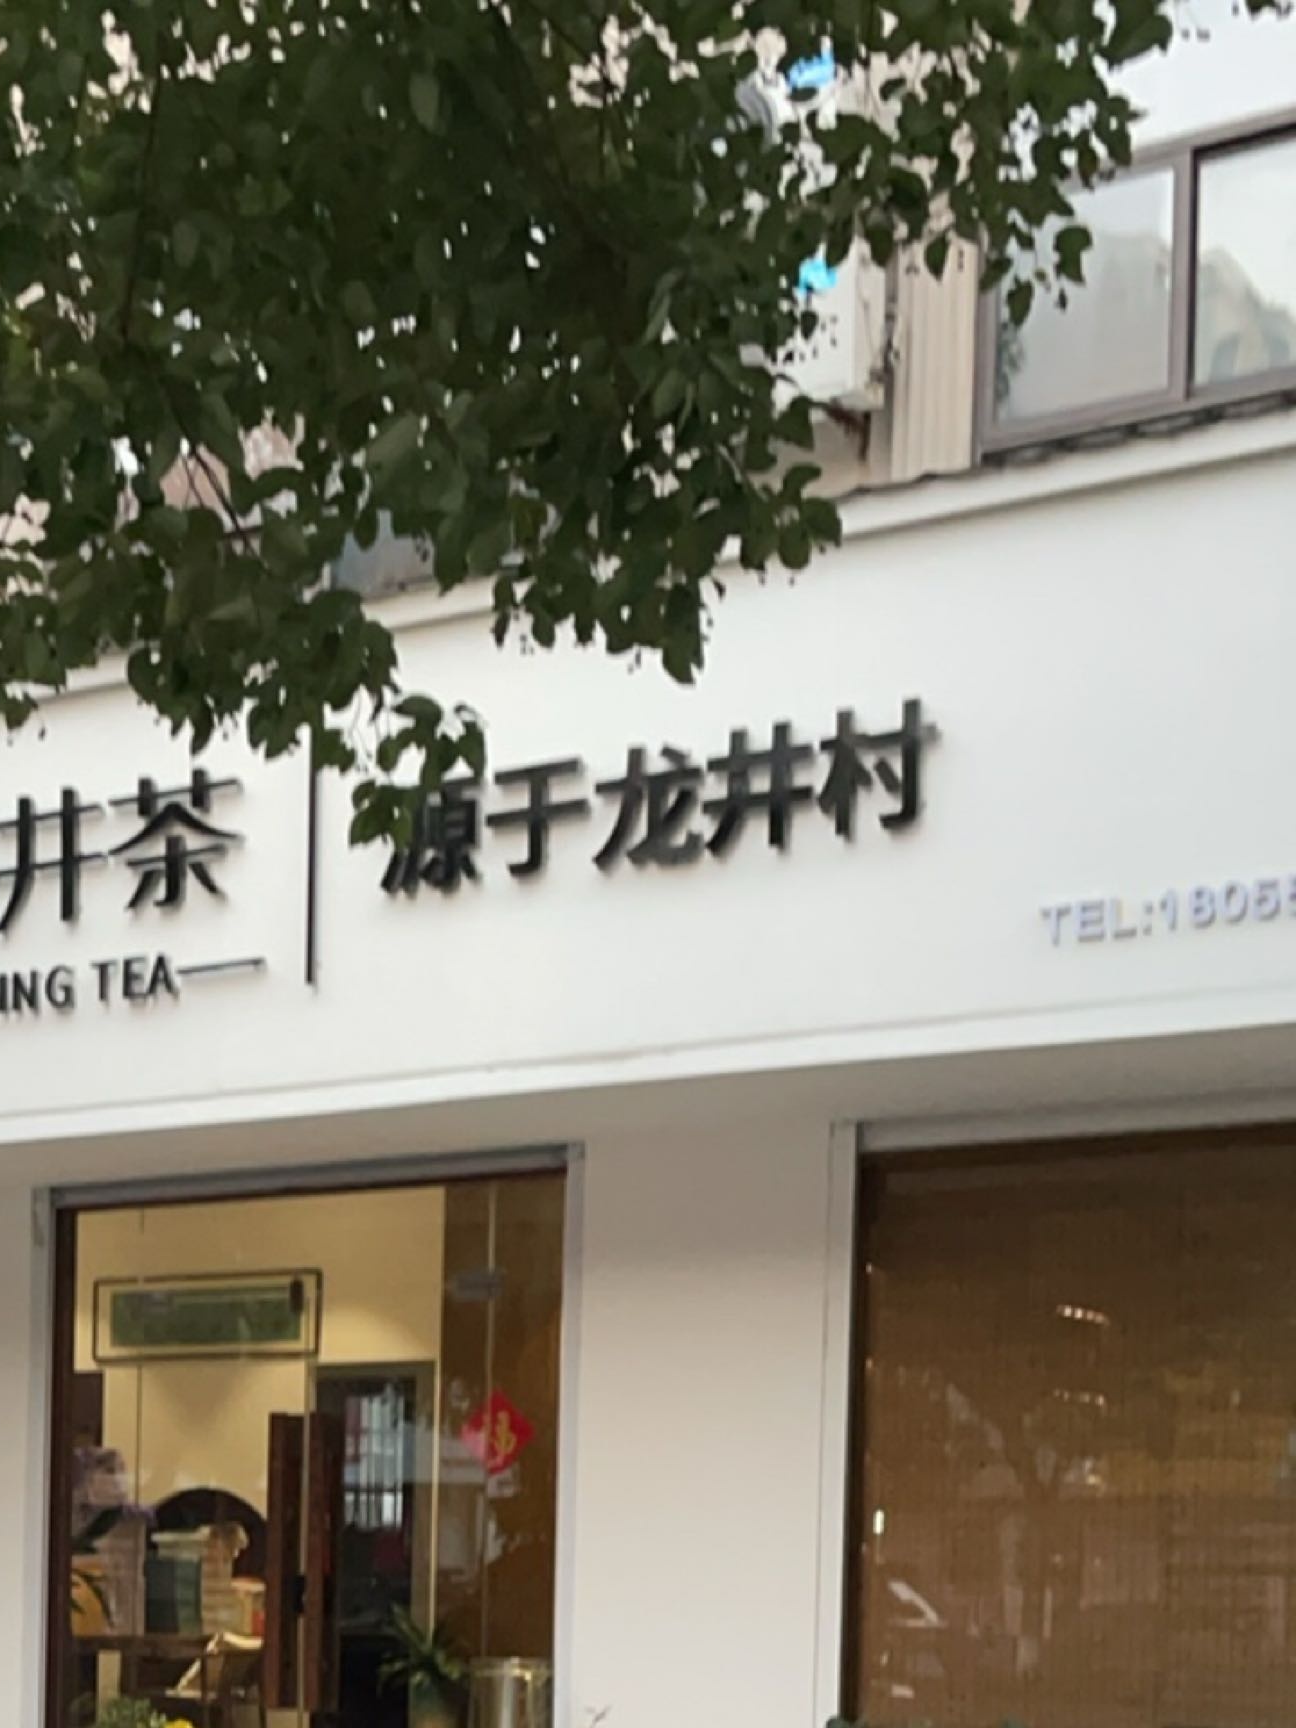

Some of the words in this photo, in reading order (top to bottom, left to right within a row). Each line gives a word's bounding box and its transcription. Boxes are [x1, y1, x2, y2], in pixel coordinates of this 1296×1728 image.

[380, 698, 940, 896] 源于龙井村
[1039, 872, 1296, 947] TEL:1805
[89, 953, 180, 1002] TEA
